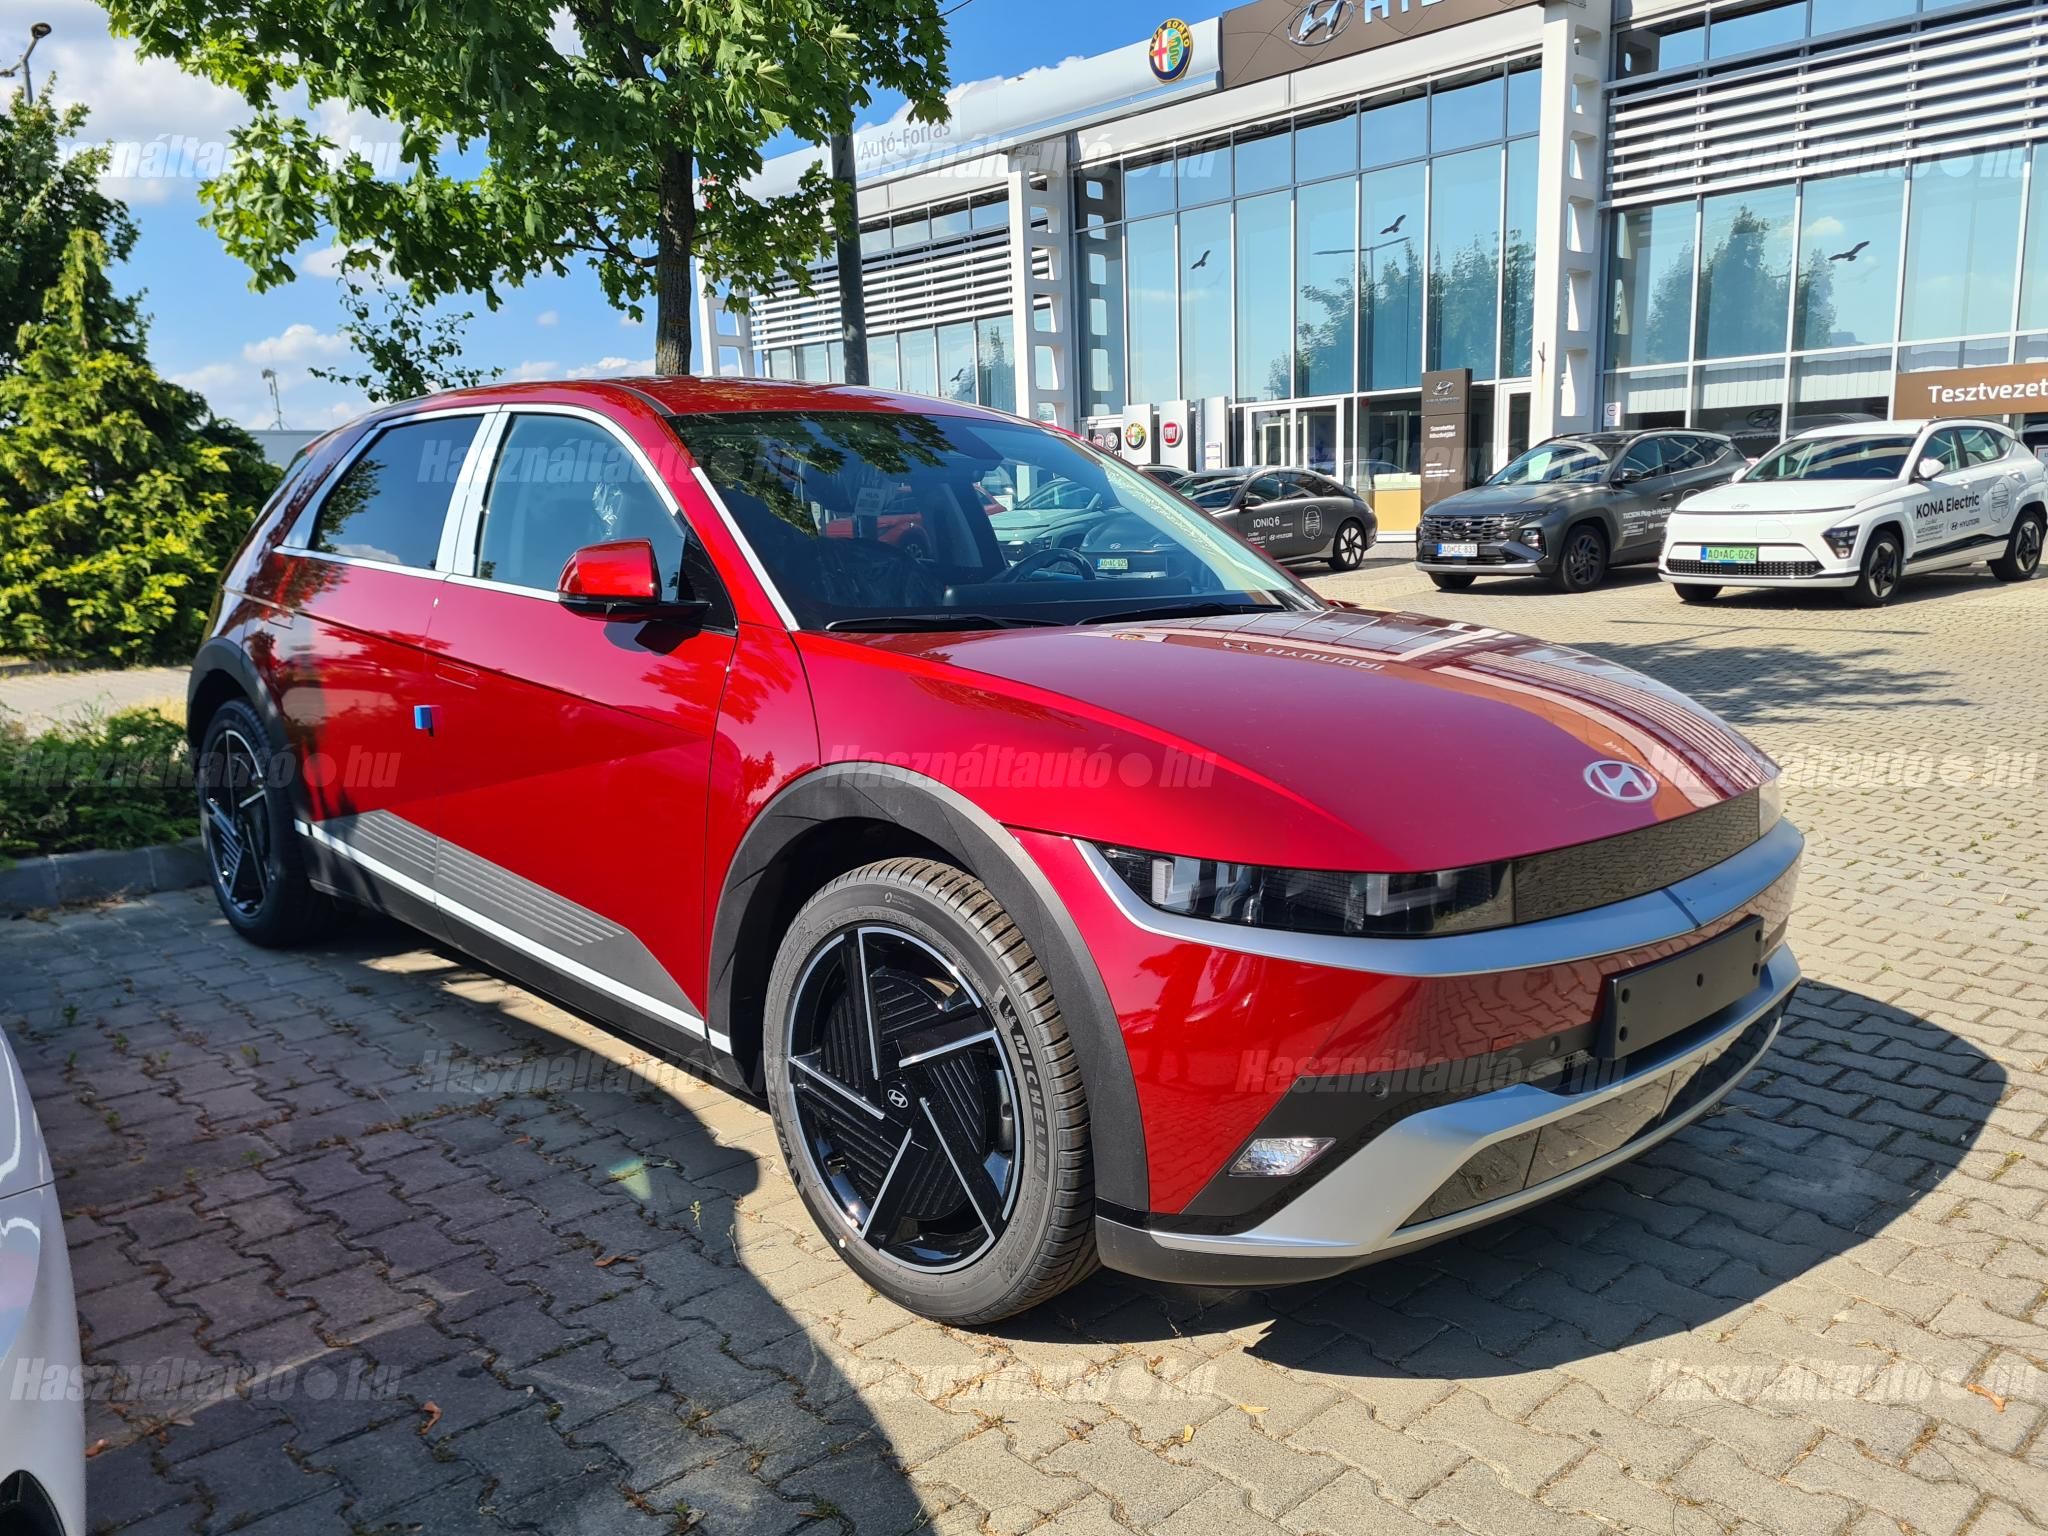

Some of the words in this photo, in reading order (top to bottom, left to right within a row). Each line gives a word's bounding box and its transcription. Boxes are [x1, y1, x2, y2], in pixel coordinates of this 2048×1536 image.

[1916, 500, 1945, 519] KONA
[1946, 491, 1980, 512] Electric
[1253, 517, 1274, 528] IONIQ
[1275, 516, 1280, 526] 6
[1013, 1034, 1047, 1173] MICHELIN
